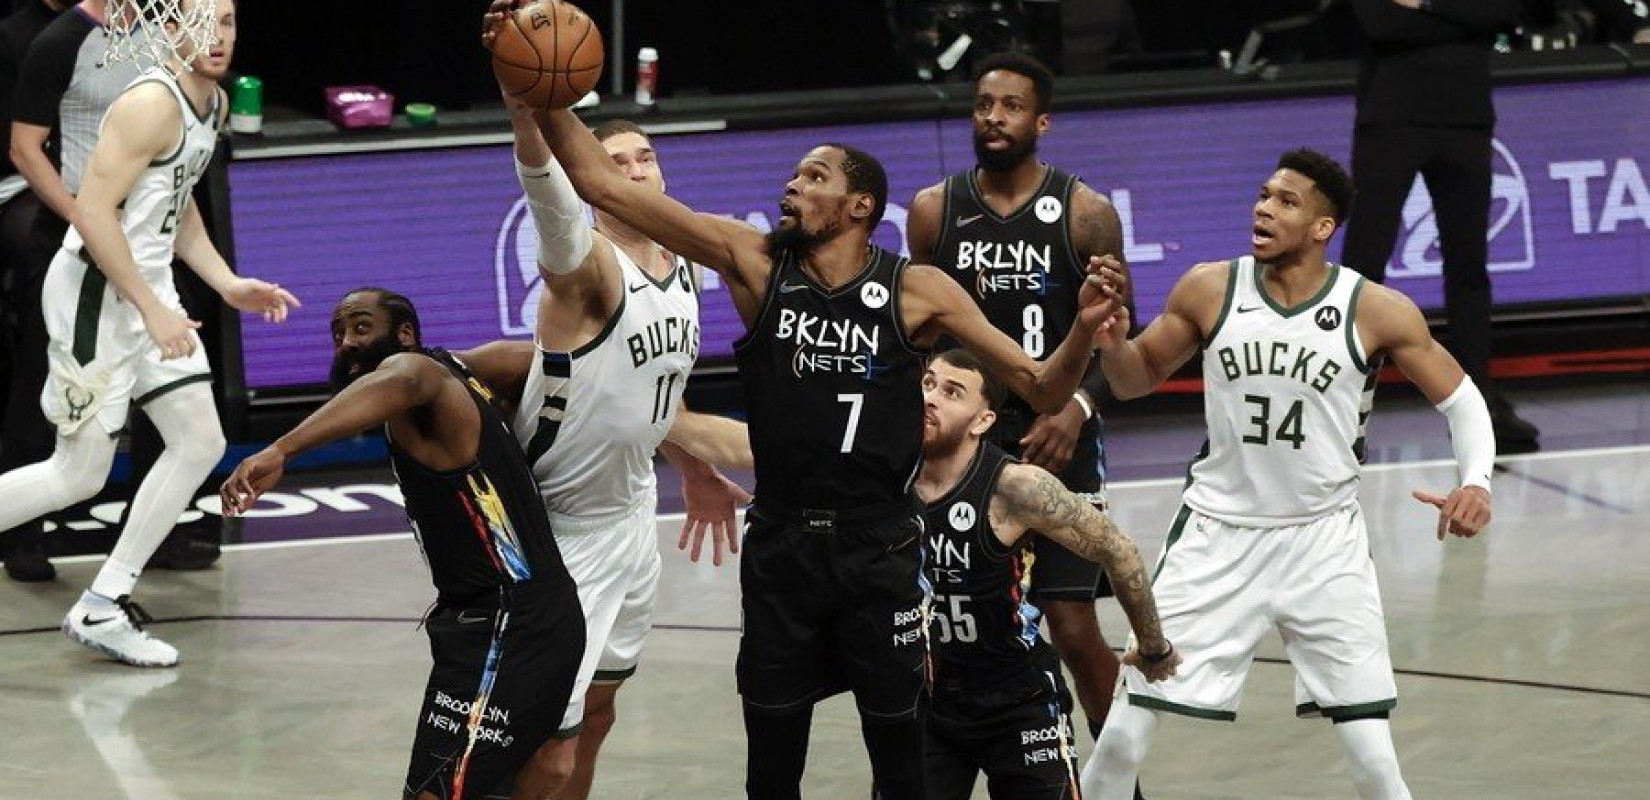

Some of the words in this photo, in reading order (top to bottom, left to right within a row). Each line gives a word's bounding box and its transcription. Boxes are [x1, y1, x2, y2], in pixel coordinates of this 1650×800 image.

[1548, 159, 1650, 234] TA
[1111, 189, 1163, 262] L
[955, 240, 1051, 273] BKLYN
[775, 308, 879, 356] BKLYN
[1023, 304, 1044, 358] 8
[1219, 341, 1342, 394] BUCKS
[651, 372, 679, 424] 11
[837, 393, 864, 453] 7
[1243, 394, 1305, 450] 34
[930, 533, 971, 570] YN
[932, 567, 963, 584] TS
